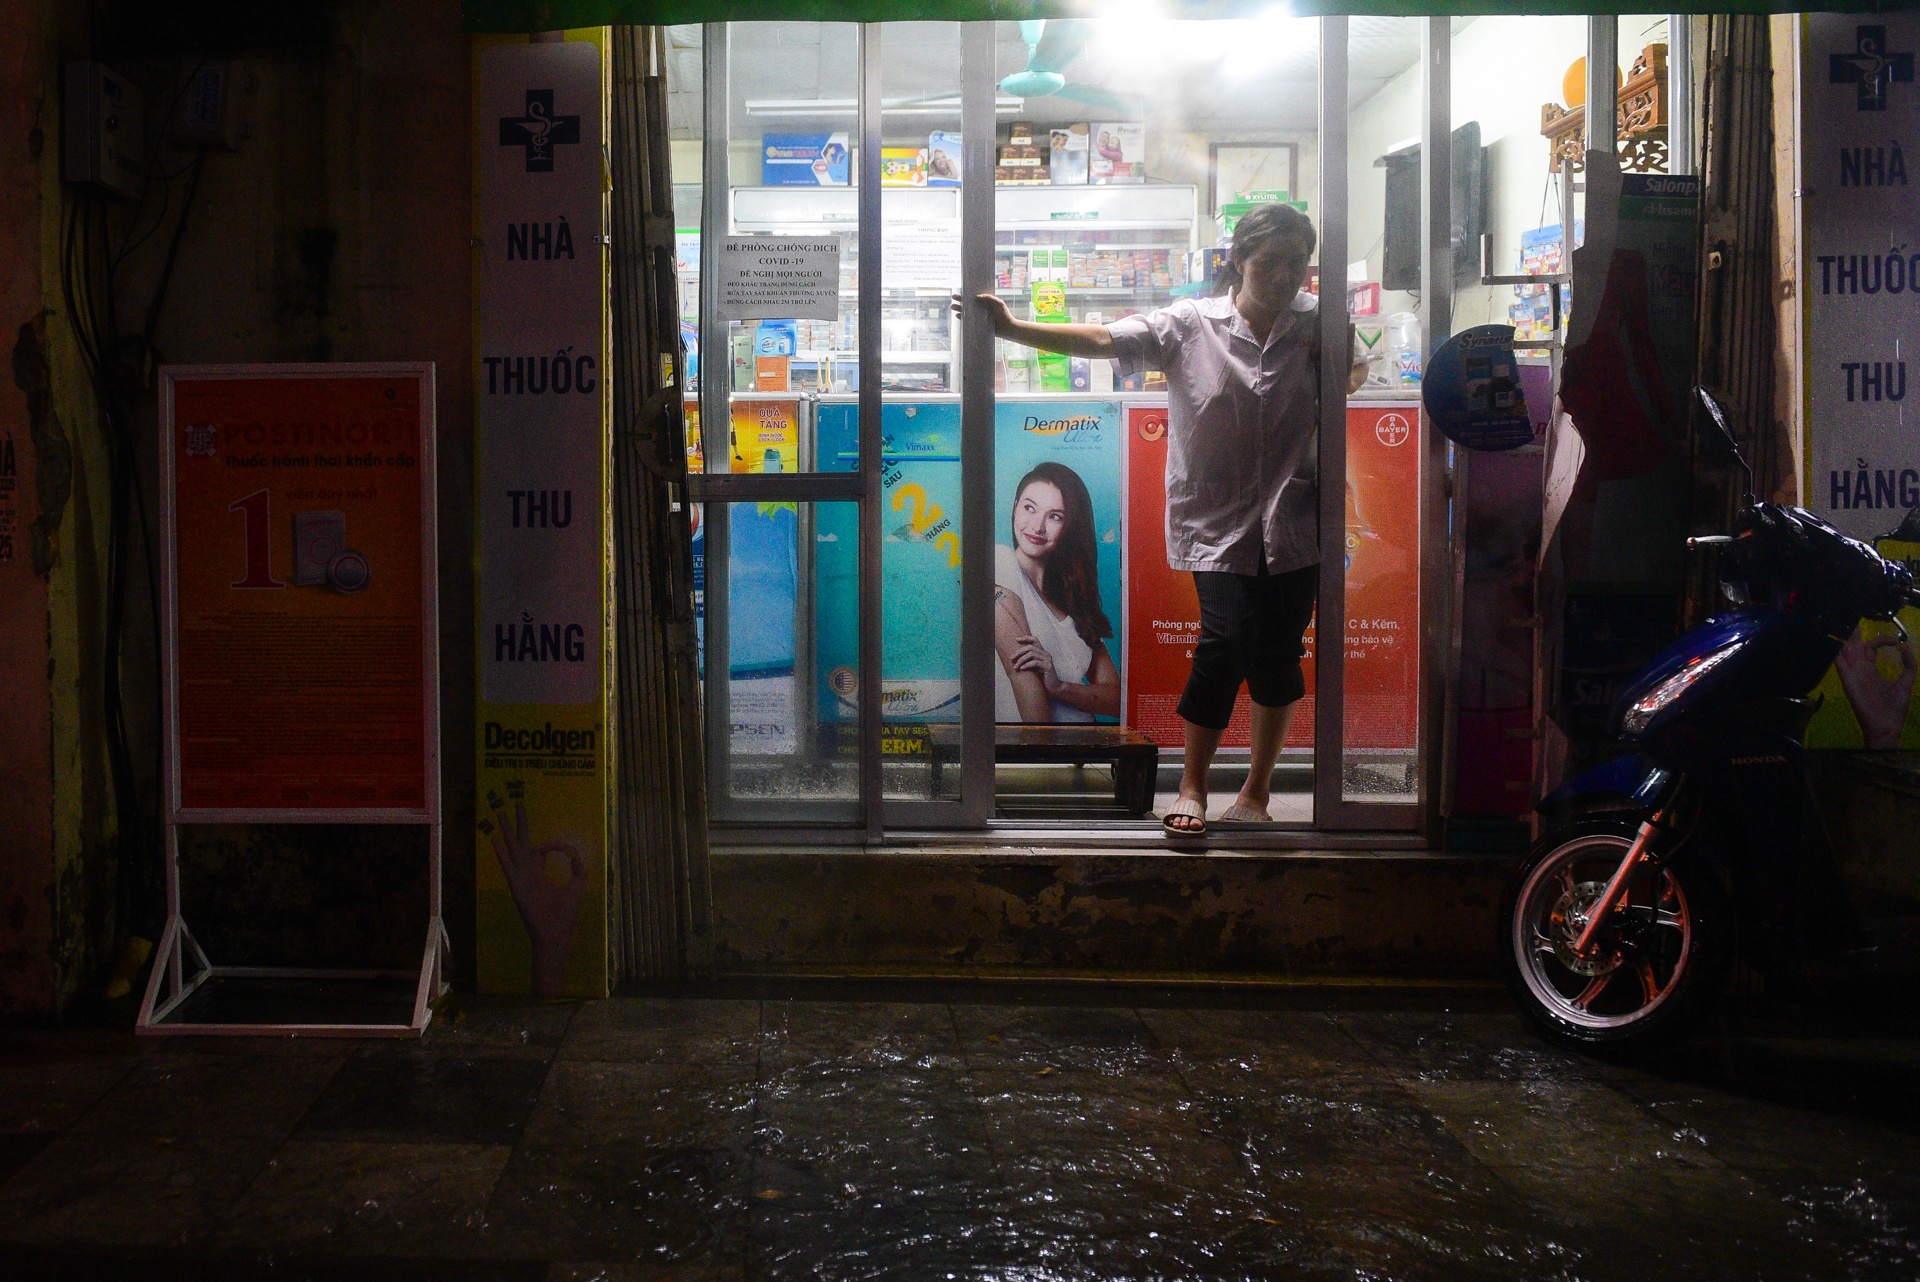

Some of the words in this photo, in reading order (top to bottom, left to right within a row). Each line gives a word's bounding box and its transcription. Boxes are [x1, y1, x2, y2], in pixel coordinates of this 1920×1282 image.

[1840, 139, 1908, 187] NHÀ
[1252, 193, 1279, 201] XYLITOL
[507, 215, 575, 261] NHÀ
[741, 242, 774, 252] PHÒNG
[758, 257, 790, 266] COVID
[791, 257, 805, 266] -19
[776, 270, 793, 279] MỌI
[795, 269, 822, 278] NGƯỜI
[482, 345, 596, 395] THUỐC
[1840, 362, 1906, 402] THU
[759, 406, 781, 418] QUÀ
[759, 418, 787, 431] TẶNG
[1024, 416, 1101, 431] Dermatix
[224, 421, 388, 446] POSTINOR
[905, 443, 935, 451] Vimaxx
[225, 453, 268, 468] Thuốc
[272, 455, 310, 468] tránh
[314, 454, 342, 468] thai
[346, 452, 382, 467] khẩn
[386, 452, 415, 468] cấp
[883, 470, 903, 489] SAU
[1830, 457, 1920, 510] HẰNG
[506, 490, 572, 528] THU
[228, 488, 286, 590] 1
[1152, 620, 1182, 631] Phòng
[1348, 619, 1358, 629] C
[1360, 619, 1369, 629] &
[495, 611, 585, 662] HẰNG
[1156, 632, 1199, 644] Vitamin
[1361, 636, 1379, 645] bảo
[1382, 637, 1394, 645] vệ
[1185, 649, 1193, 658] &
[881, 688, 918, 704] matix
[484, 722, 595, 754] Decolgen
[485, 757, 503, 768] ĐIỀU
[518, 759, 524, 768] 3
[1730, 755, 1787, 765] HONDA
